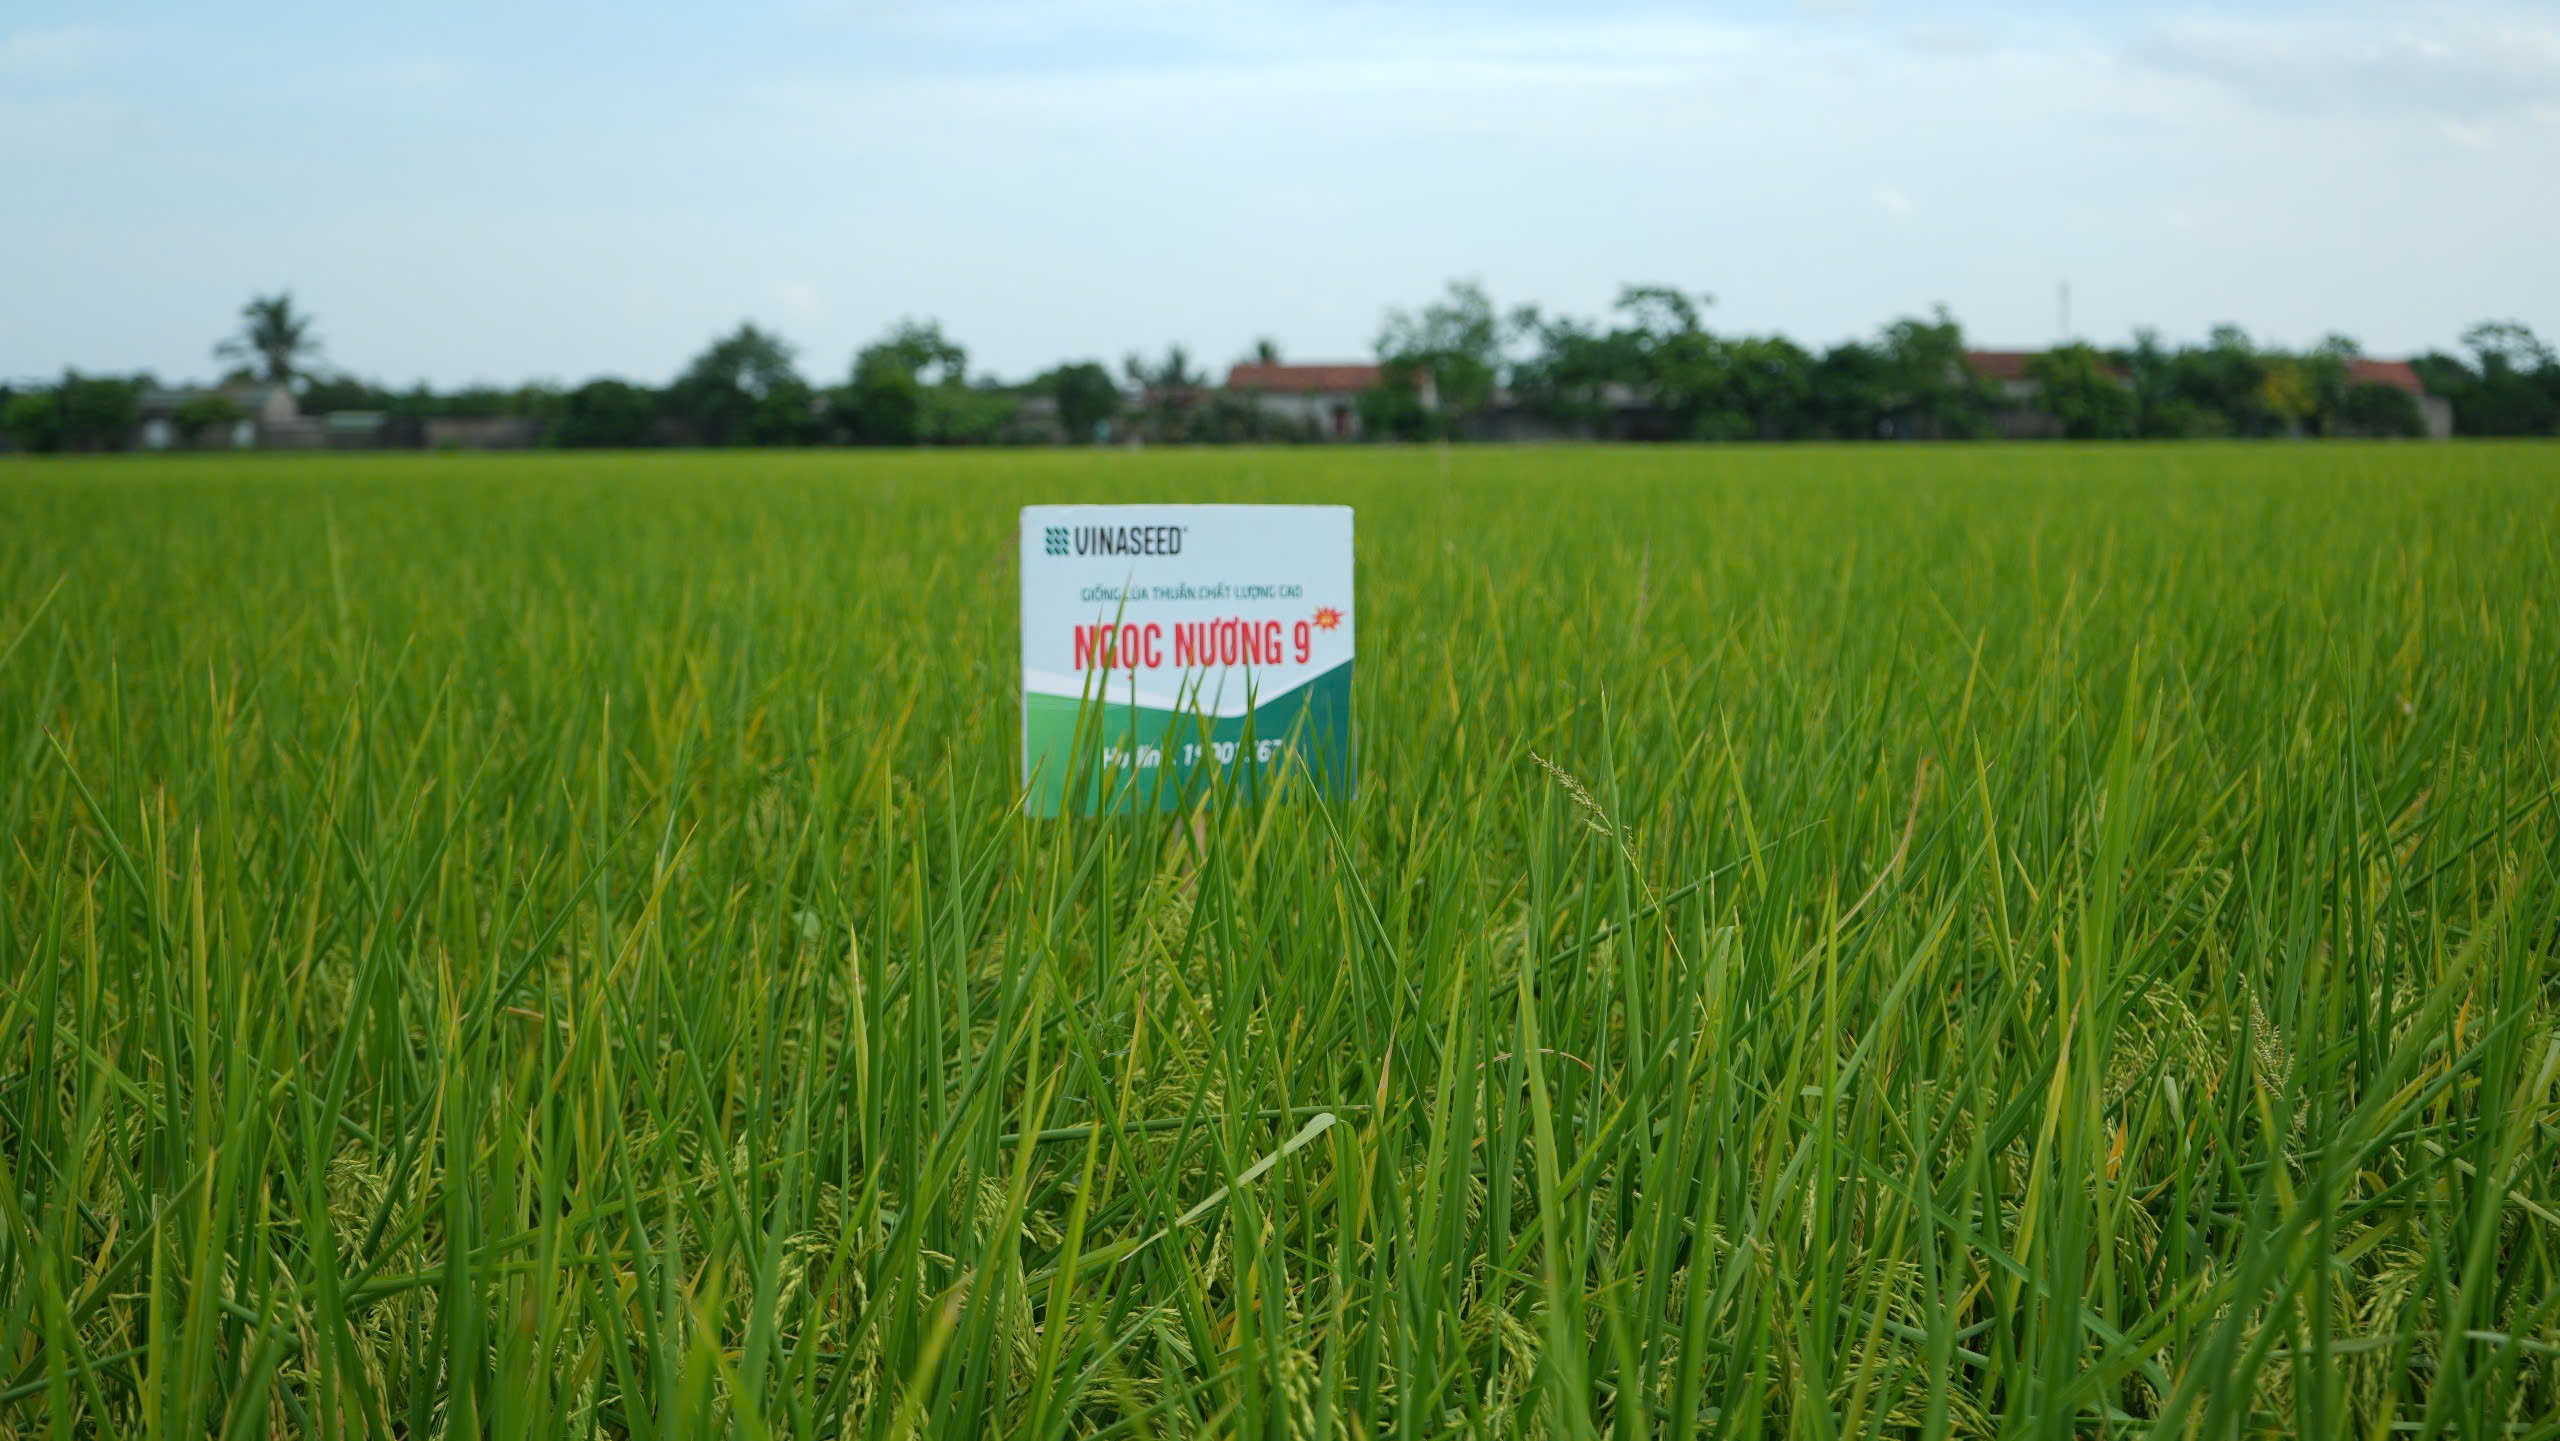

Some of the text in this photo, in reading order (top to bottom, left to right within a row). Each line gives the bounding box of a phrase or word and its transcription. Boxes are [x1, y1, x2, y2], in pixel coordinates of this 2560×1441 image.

[1074, 526, 1181, 555] VINASEED
[1279, 584, 1304, 599] CAO
[1073, 616, 1311, 680] NGỌC NƯƠNG 9
